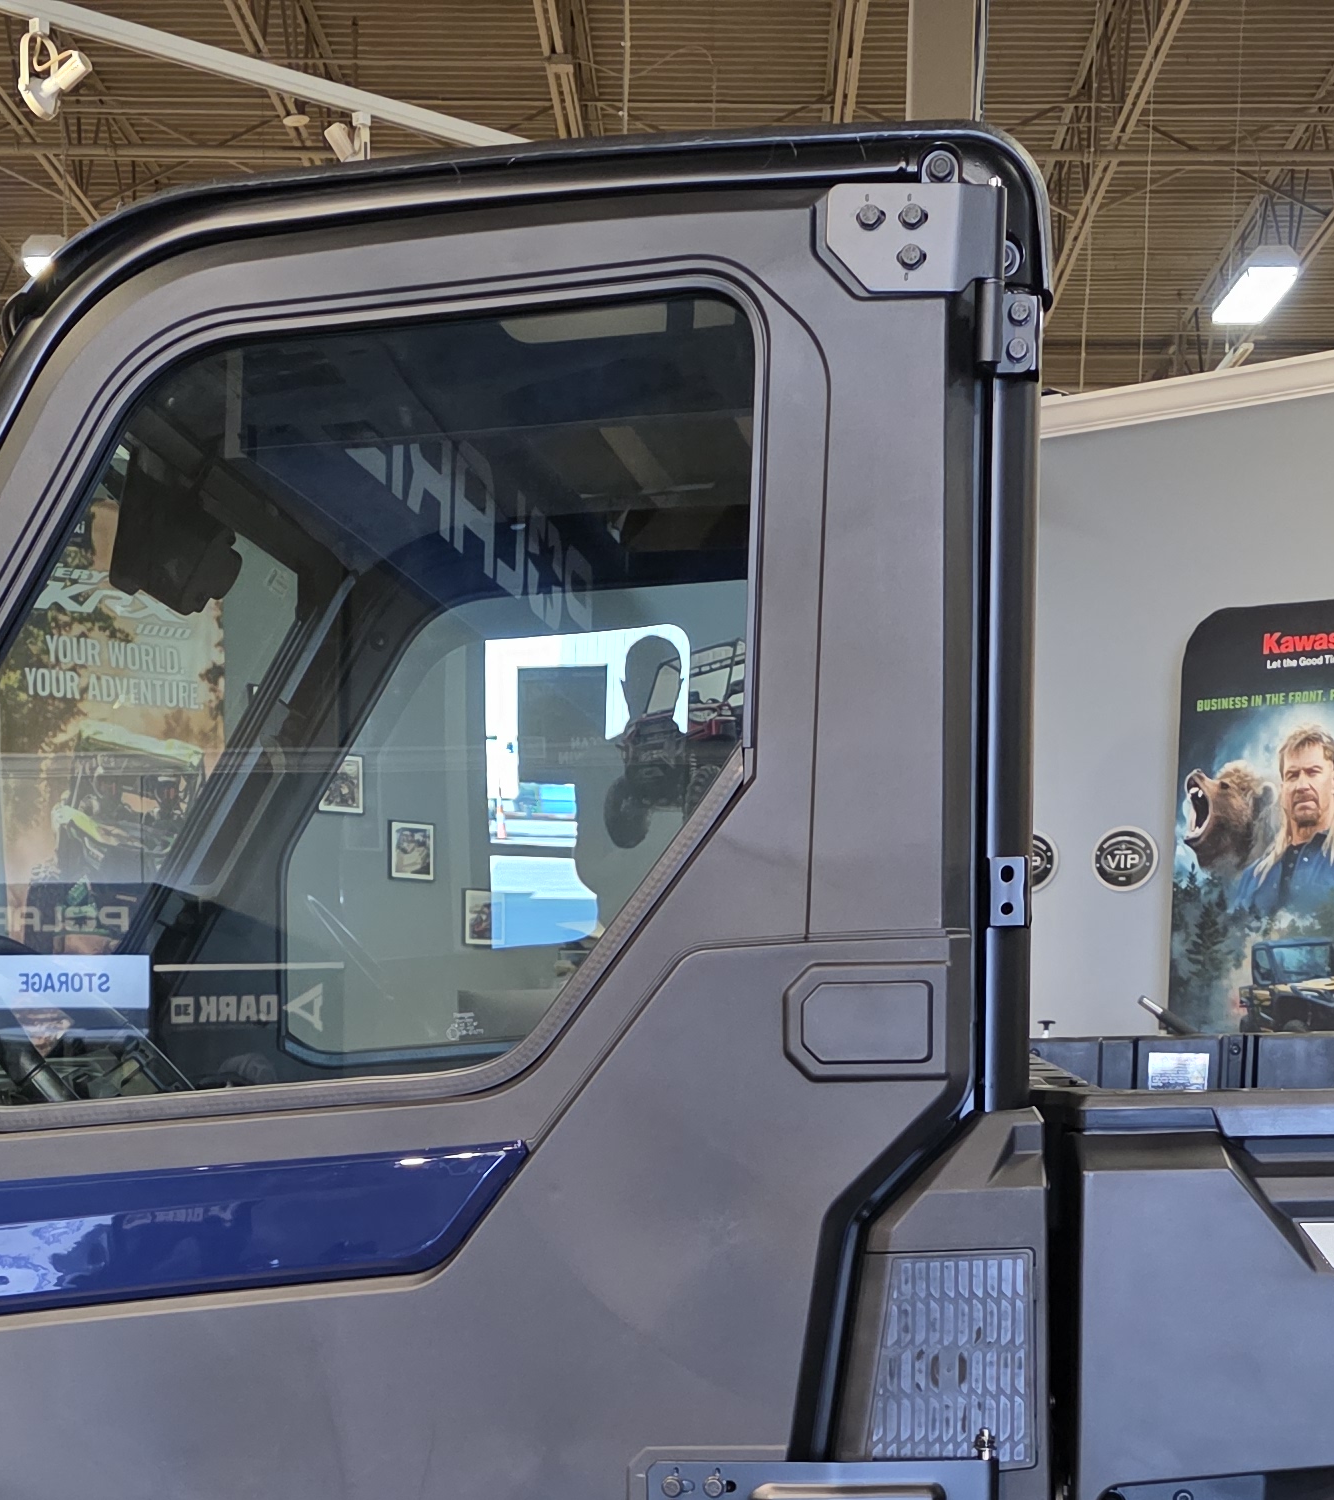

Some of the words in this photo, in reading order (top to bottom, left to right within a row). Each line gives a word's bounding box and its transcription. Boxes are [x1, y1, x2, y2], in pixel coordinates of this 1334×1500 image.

[136, 624, 191, 639] 1000
[45, 635, 101, 666] YOUR
[109, 641, 184, 675] WORLD.
[1267, 660, 1281, 669] Let
[1283, 658, 1297, 667] the
[1299, 656, 1323, 666] Good
[24, 667, 80, 700] YOUR
[88, 672, 204, 709] ADVENTURE.
[1196, 696, 1248, 712] BUSINESS
[1251, 695, 1263, 707] IN
[1265, 693, 1286, 705] THE
[1288, 690, 1326, 704] FRONT.
[1107, 854, 1139, 868] VIP
